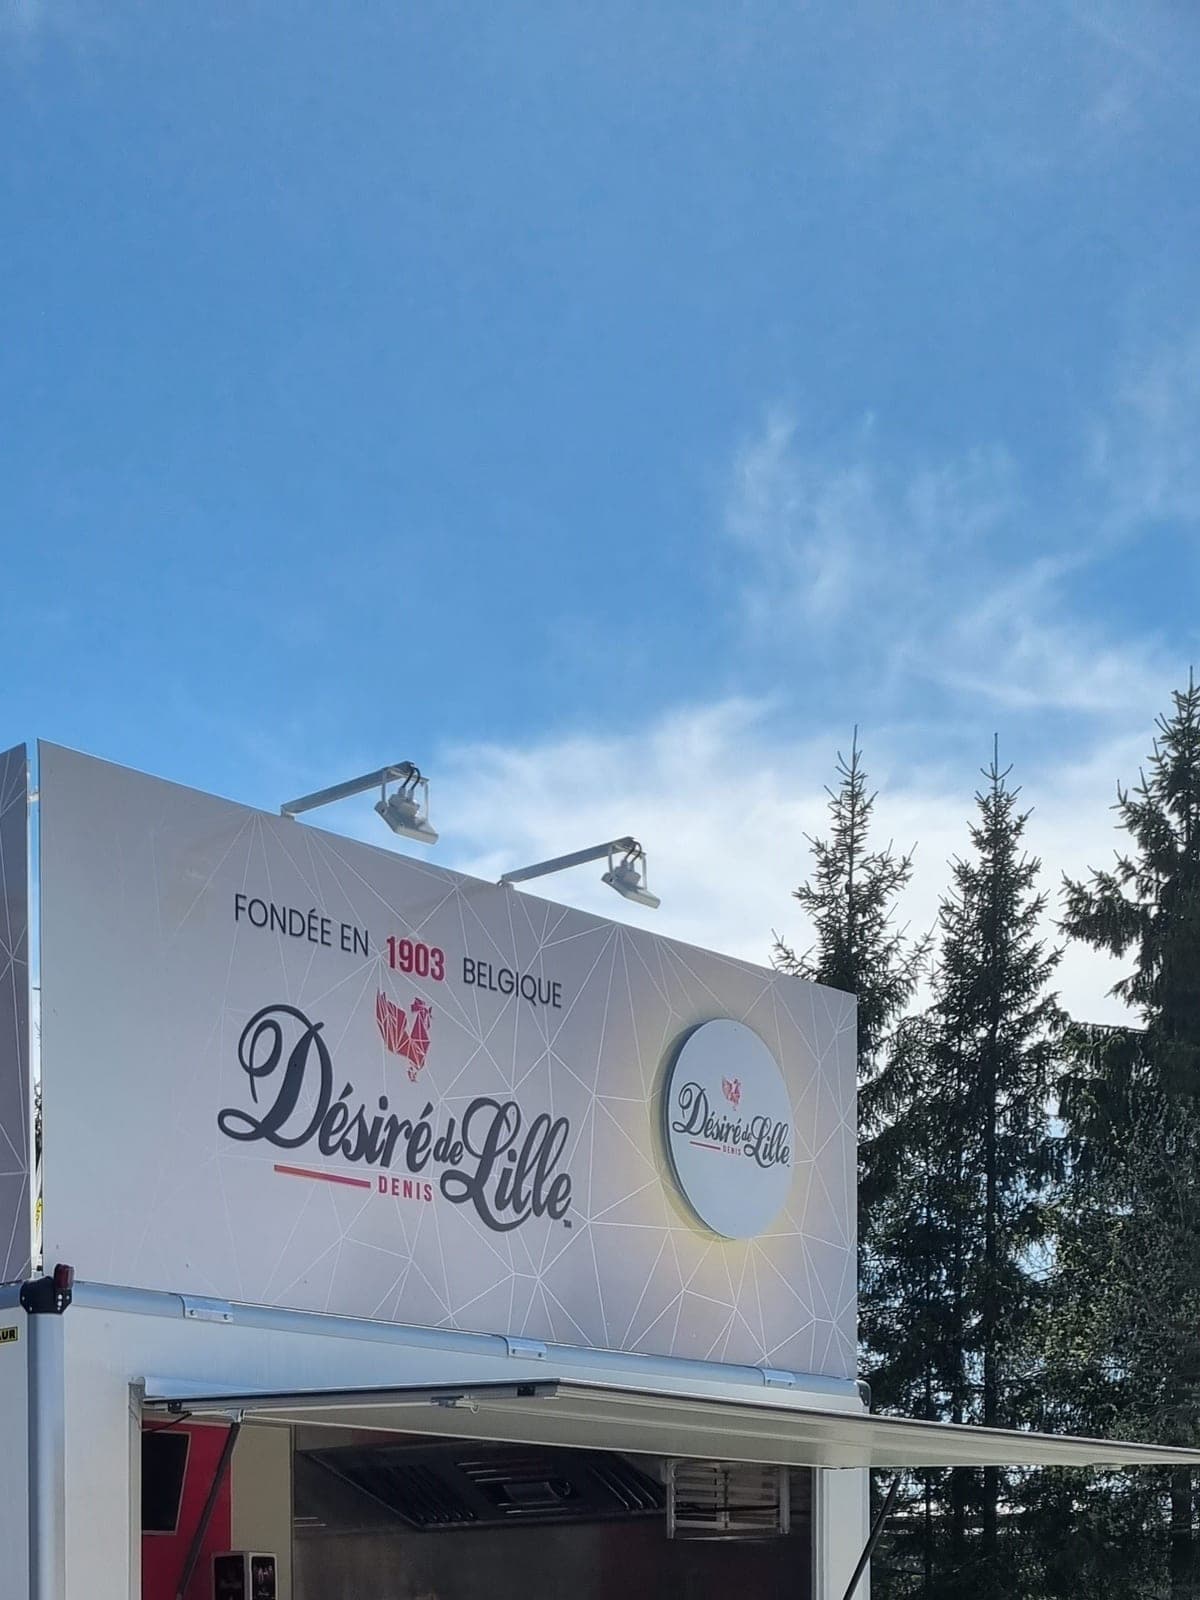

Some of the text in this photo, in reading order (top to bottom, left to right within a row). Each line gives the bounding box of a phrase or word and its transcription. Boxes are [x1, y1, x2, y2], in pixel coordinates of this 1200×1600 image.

[234, 893, 563, 1009] FONDÉE EN 1903 BELGIQUE
[217, 1003, 573, 1233] Désiré de Lille
[672, 1081, 791, 1169] Désiré de Lille
[377, 1174, 434, 1203] DENIS
